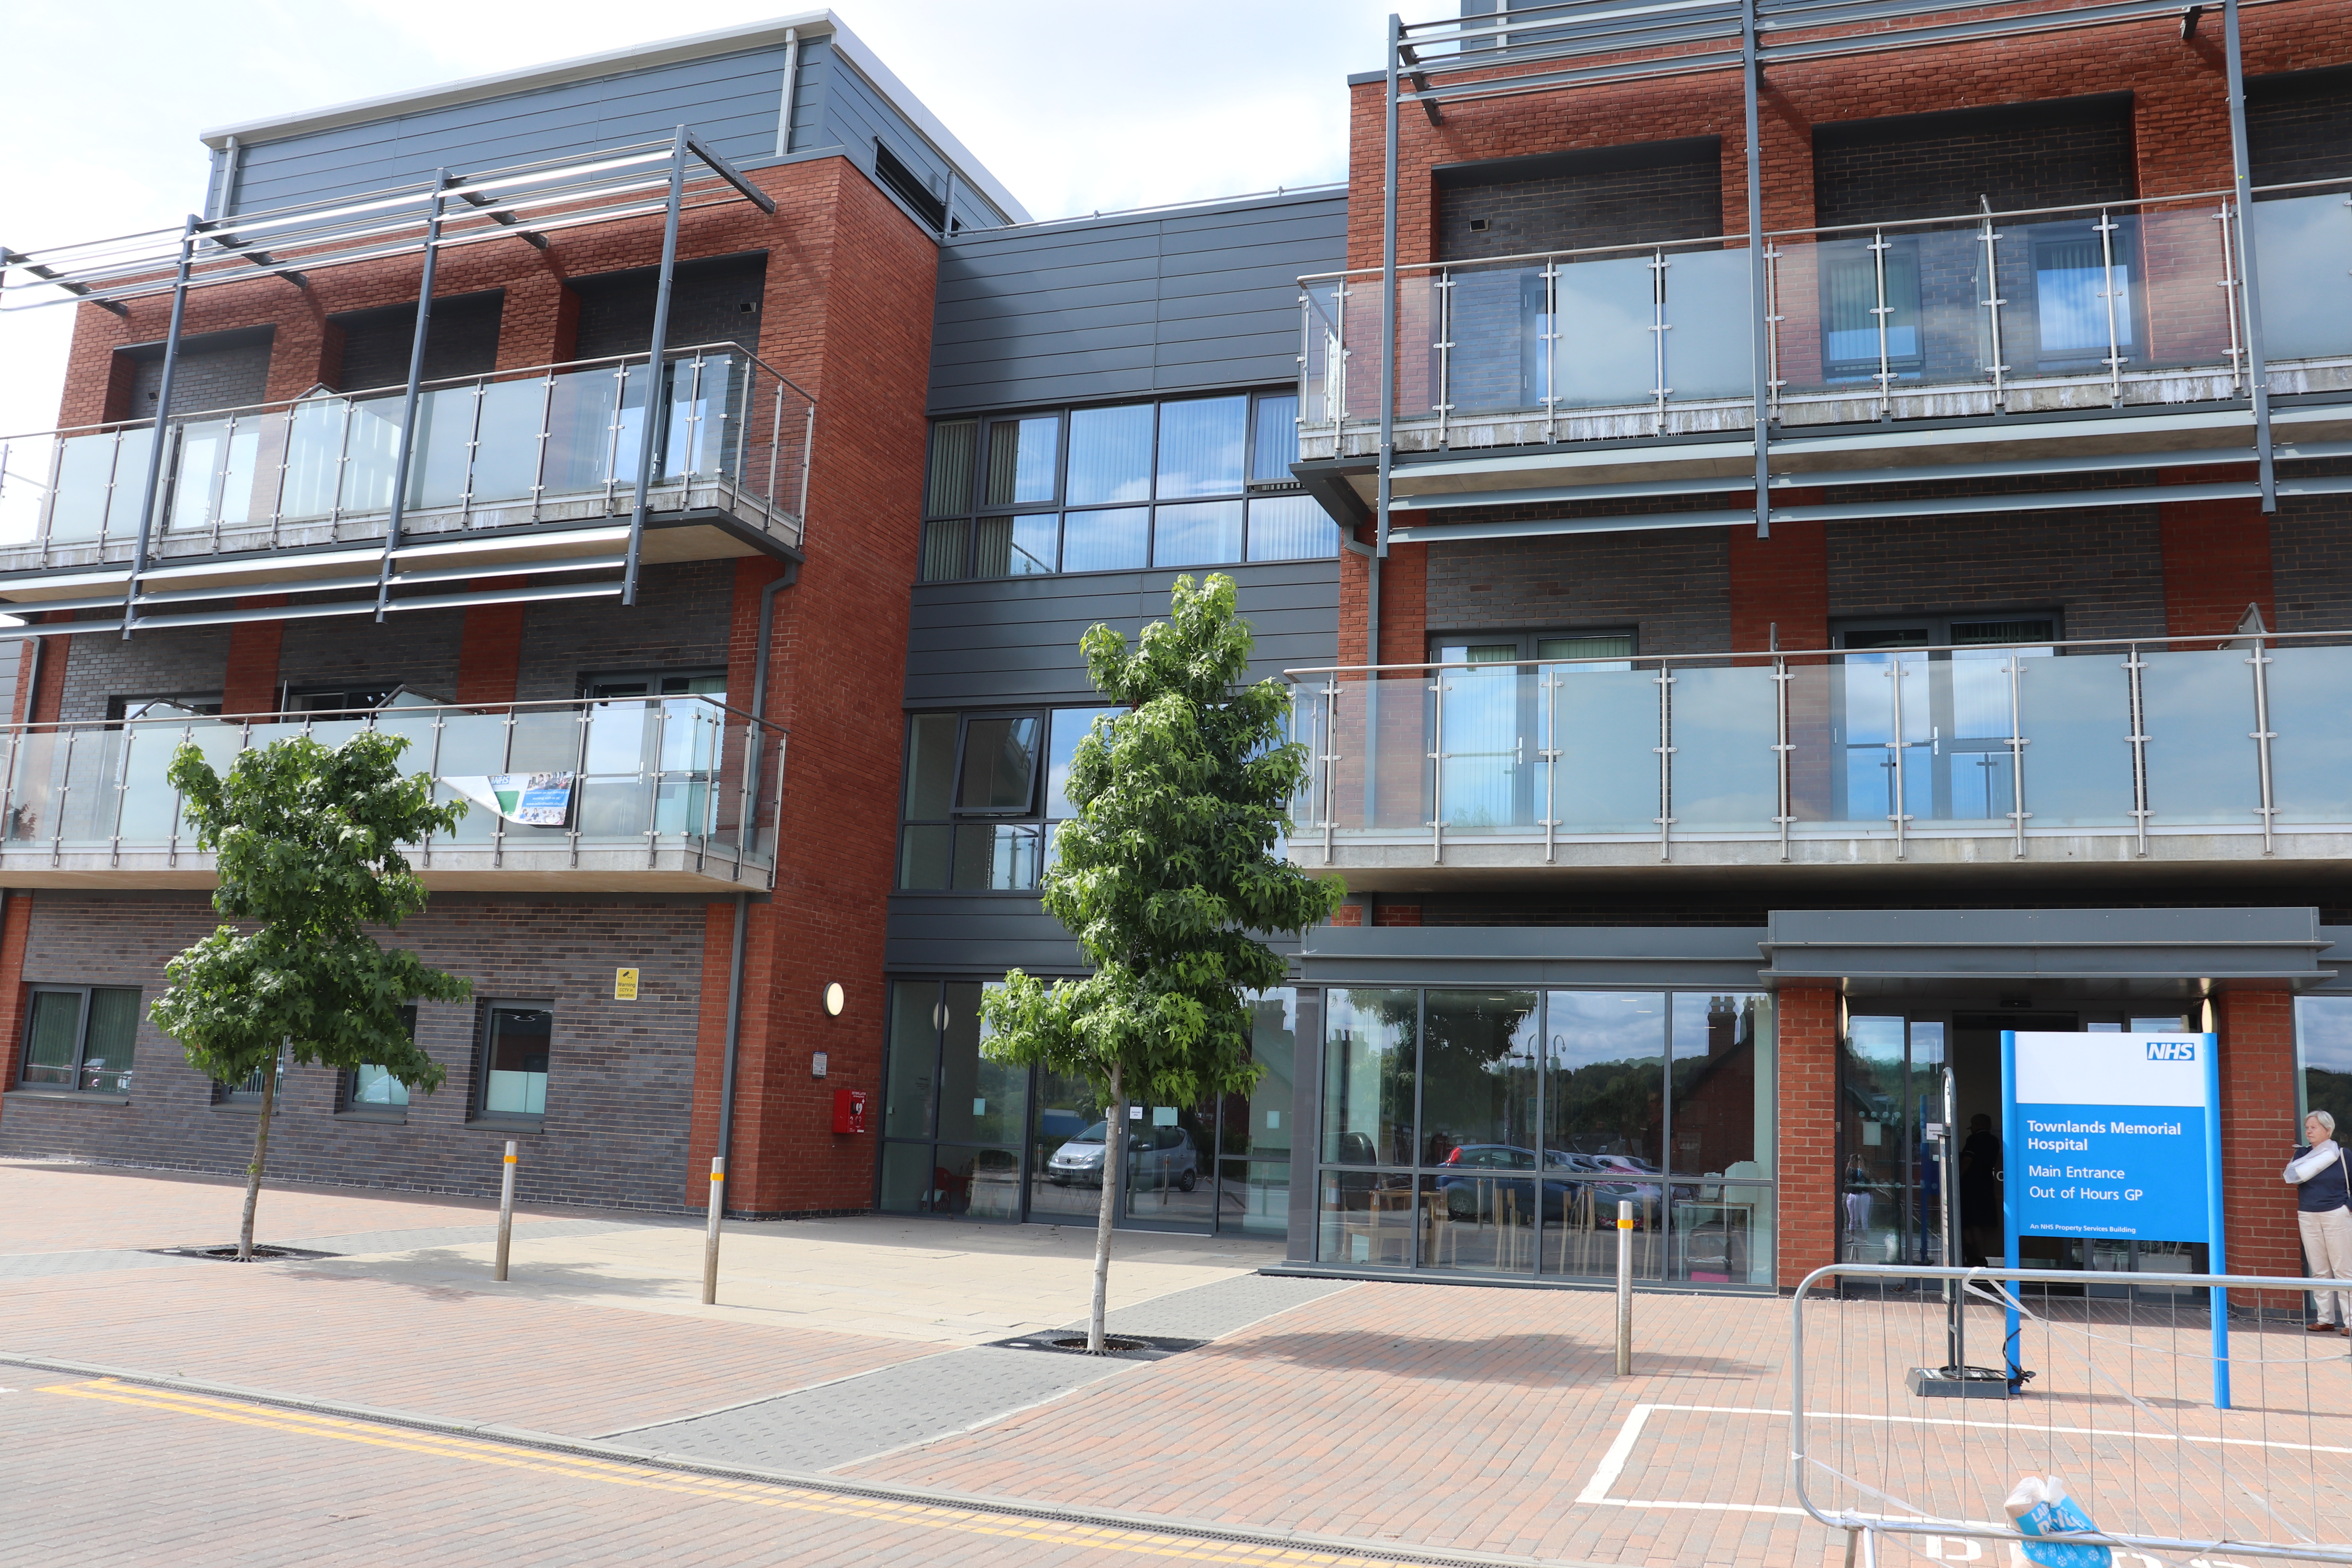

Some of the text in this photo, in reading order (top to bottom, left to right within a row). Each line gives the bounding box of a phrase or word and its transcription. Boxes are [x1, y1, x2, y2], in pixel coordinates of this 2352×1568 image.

[2148, 1044, 2193, 1060] NHS
[2027, 1120, 2181, 1135] Townlands Memorial
[2028, 1138, 2088, 1153] Hospital
[2029, 1165, 2125, 1179] Main Entrance
[2030, 1186, 2143, 1201] Out of Hours GP
